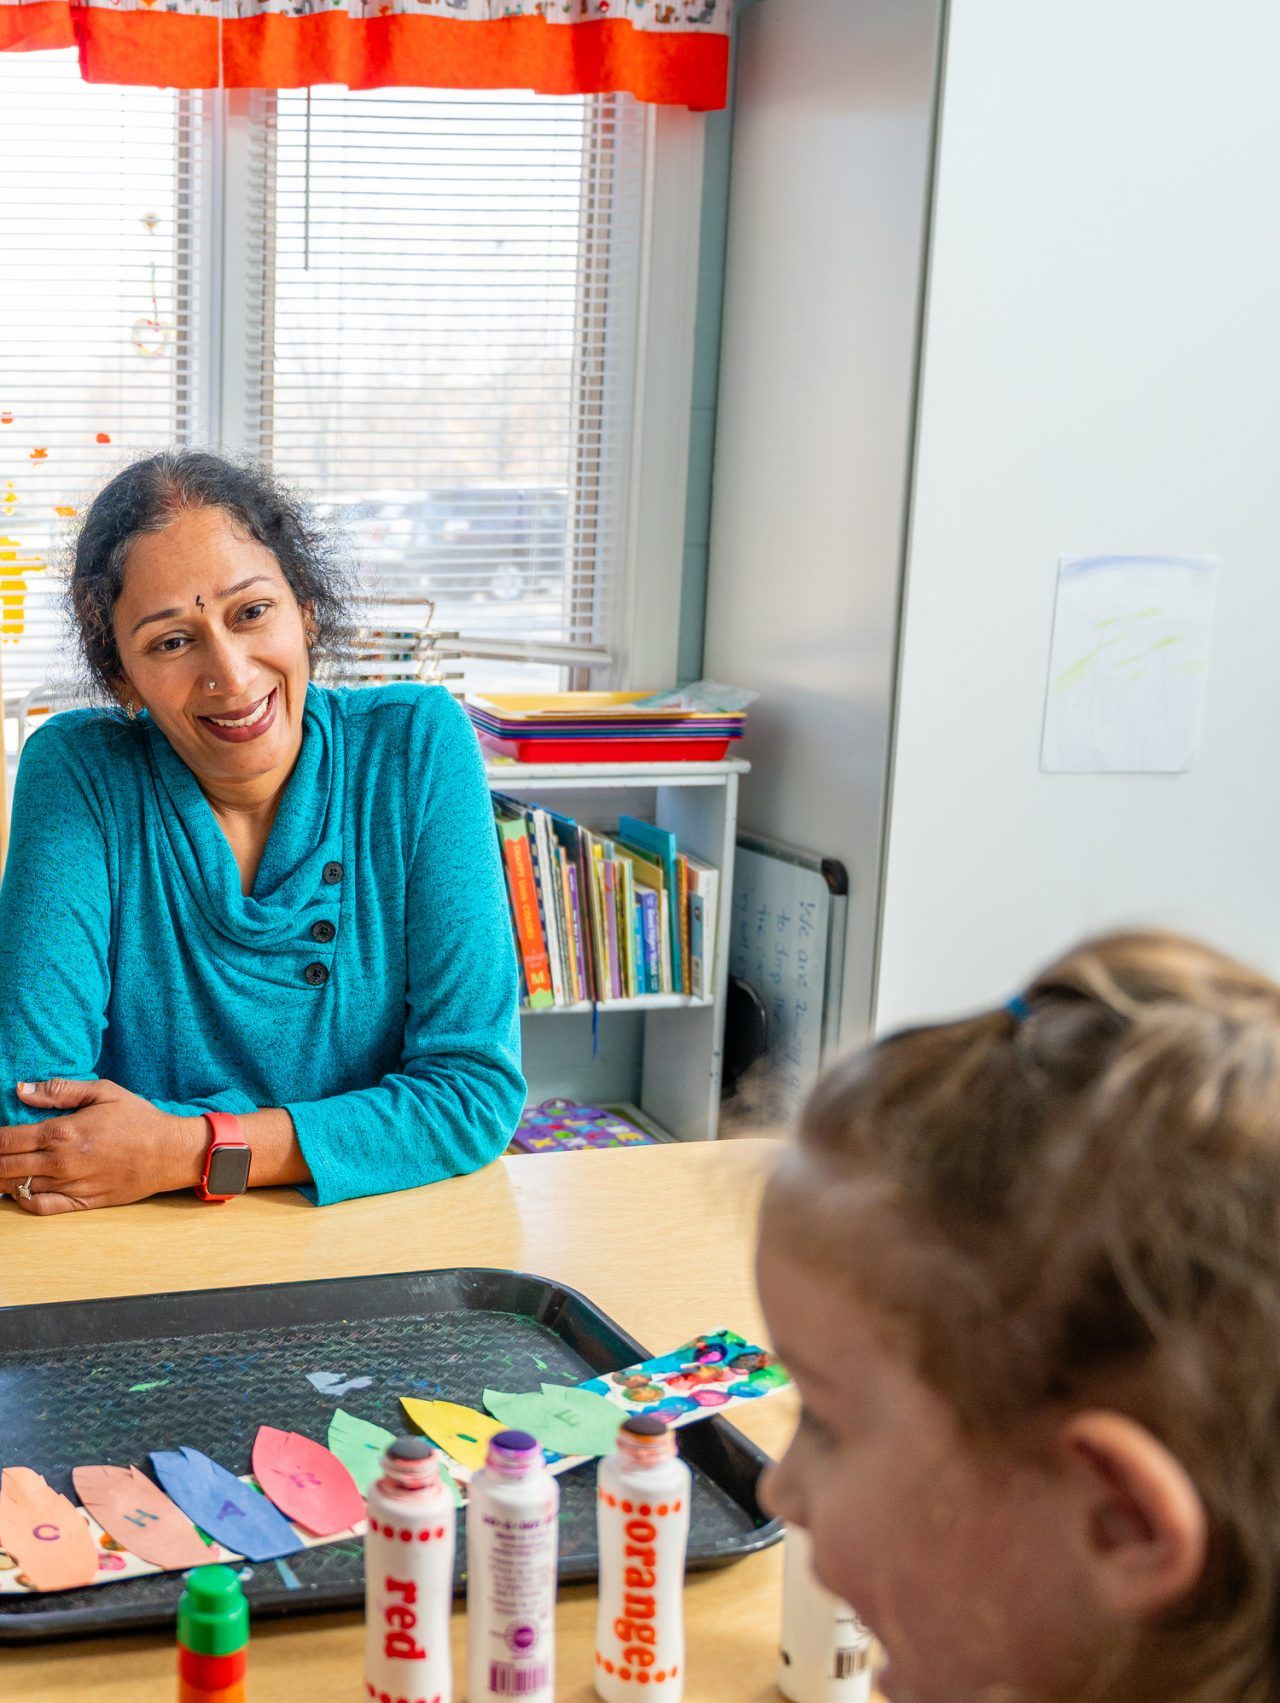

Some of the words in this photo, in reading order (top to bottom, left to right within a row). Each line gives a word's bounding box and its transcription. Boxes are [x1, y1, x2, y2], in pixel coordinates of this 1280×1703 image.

[32, 1523, 61, 1542] C
[122, 1508, 159, 1527] H
[217, 1499, 246, 1520] A
[384, 1576, 427, 1661] red
[613, 1518, 659, 1671] orange
